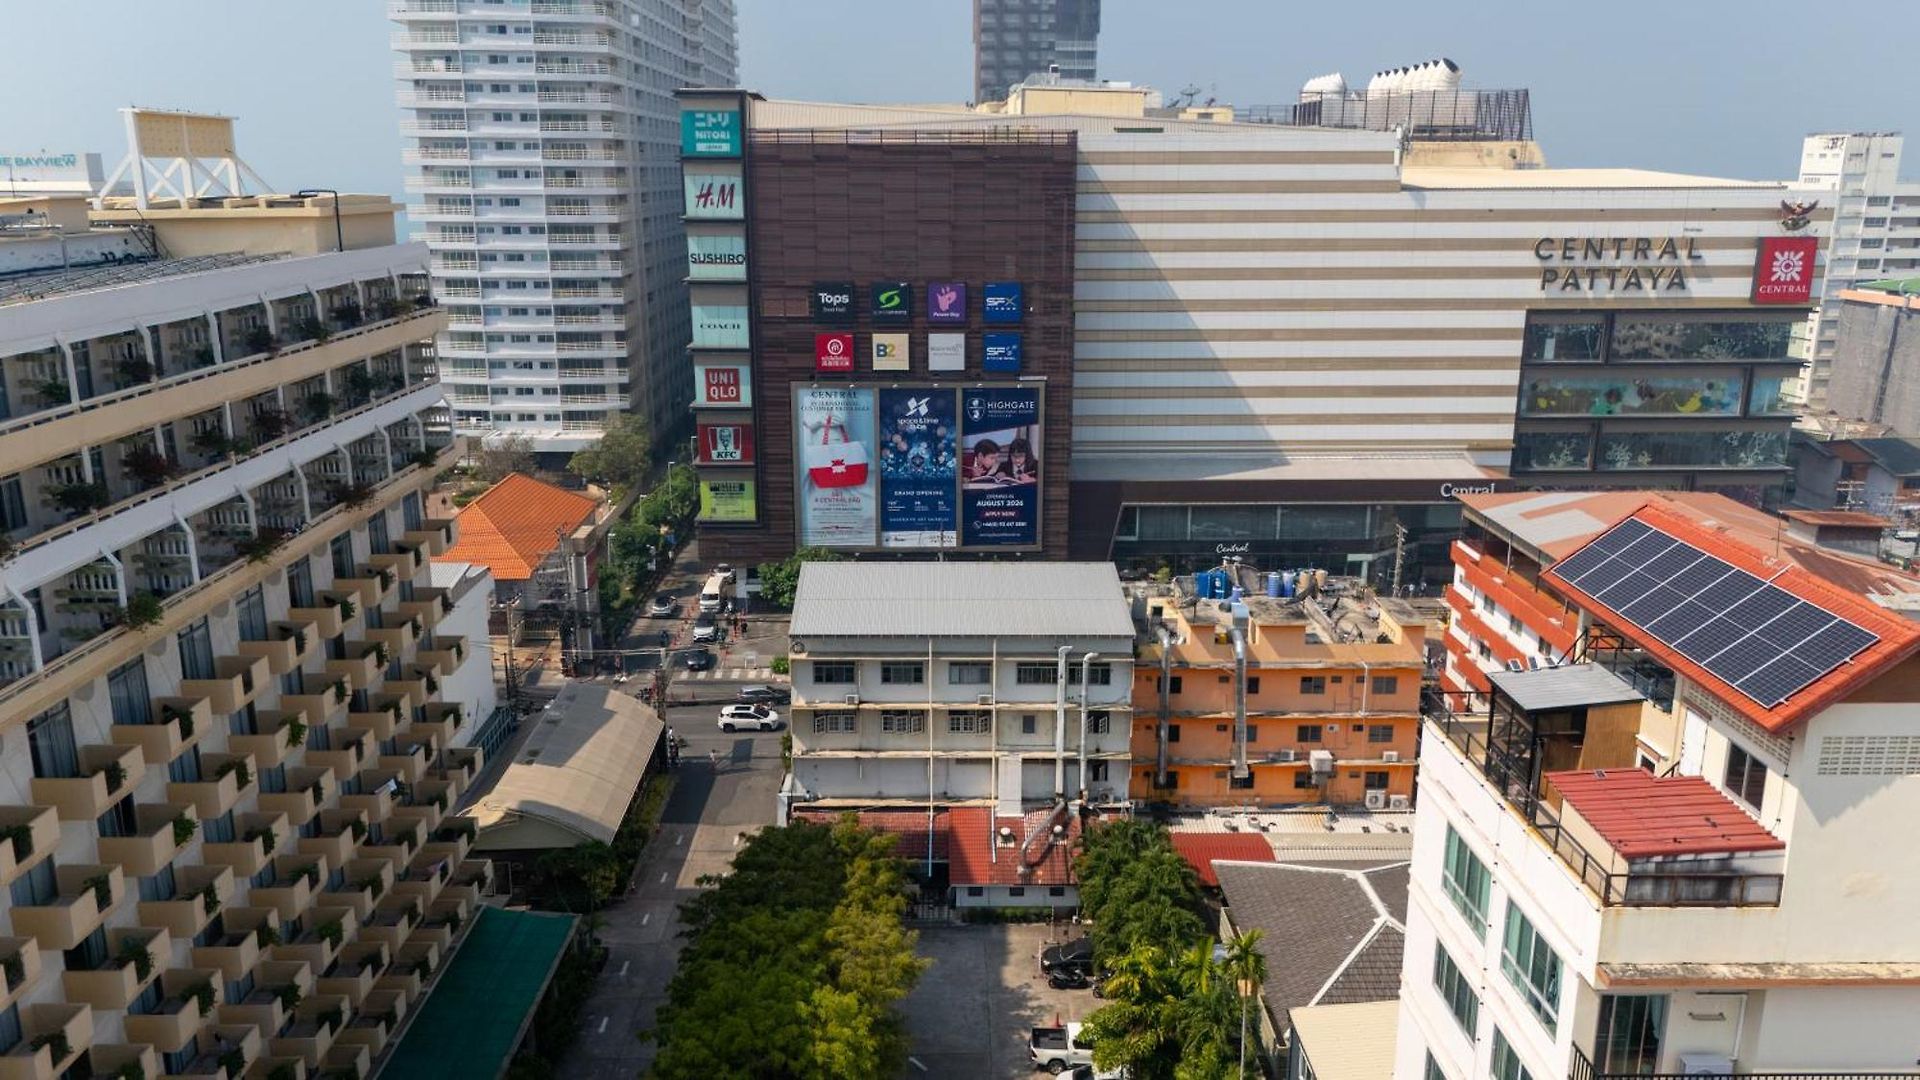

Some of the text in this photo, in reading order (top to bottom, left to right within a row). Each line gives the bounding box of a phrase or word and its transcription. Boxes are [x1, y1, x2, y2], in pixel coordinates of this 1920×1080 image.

[695, 112, 730, 127] ニトリ
[695, 130, 731, 140] NITORI
[14, 156, 76, 167] BAYVIEW
[1534, 237, 1703, 260] CENTRAL
[690, 253, 746, 265] SUSHIRO
[1540, 267, 1687, 291] PATTAYA
[1759, 284, 1808, 295] CENTRAL
[818, 292, 850, 306] Tops
[709, 371, 735, 384] UNI
[709, 386, 737, 399] QLO
[987, 401, 1035, 409] HIGHGATE
[716, 451, 738, 459] KFC
